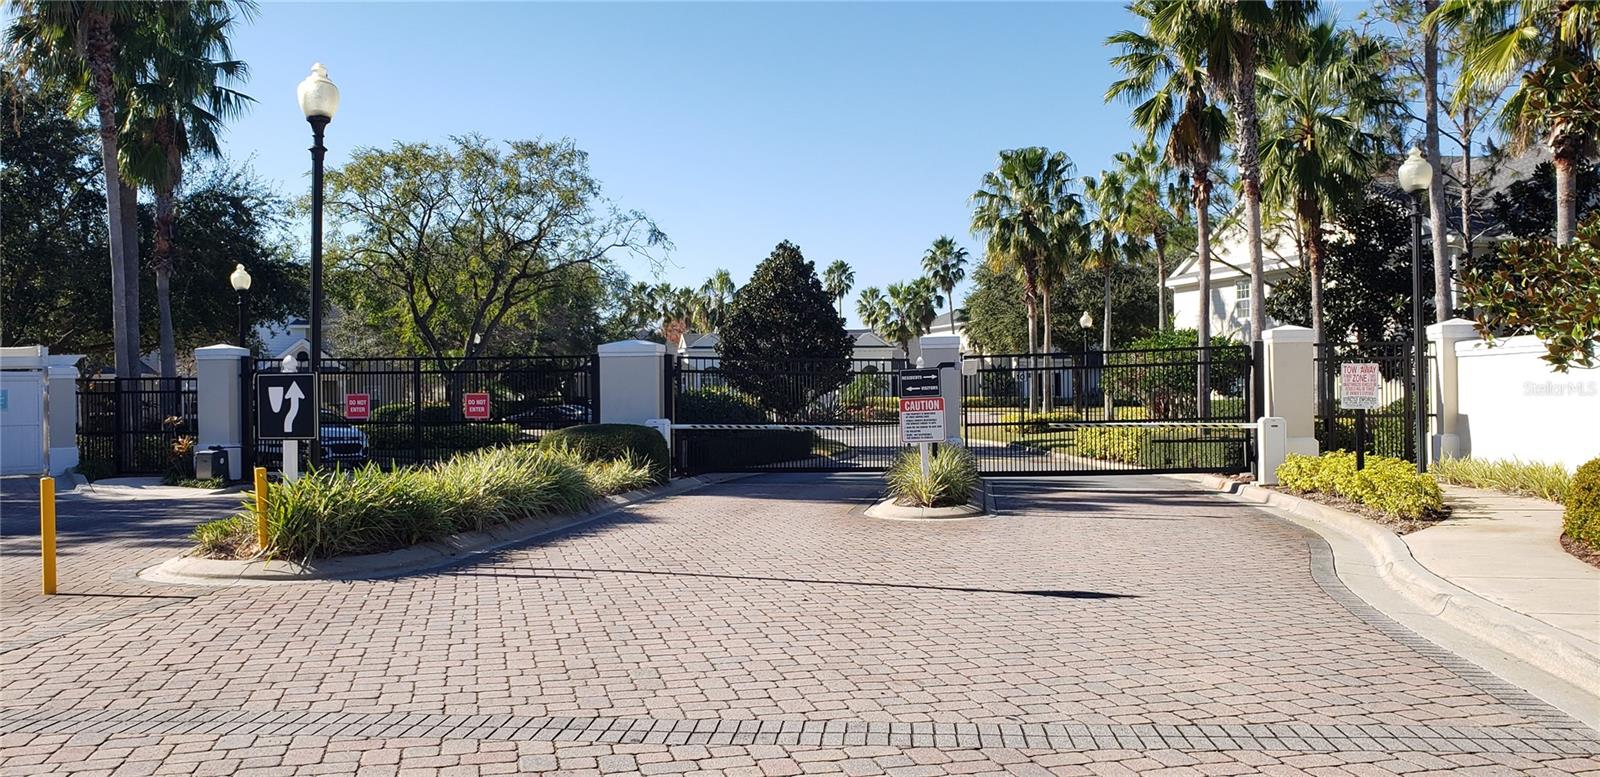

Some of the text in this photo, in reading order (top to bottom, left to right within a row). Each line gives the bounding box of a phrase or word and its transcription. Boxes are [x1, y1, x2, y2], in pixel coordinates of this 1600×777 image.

[1343, 365, 1376, 374] TOW AWAY
[1352, 374, 1367, 382] ZONE
[904, 400, 940, 410] CAUTION
